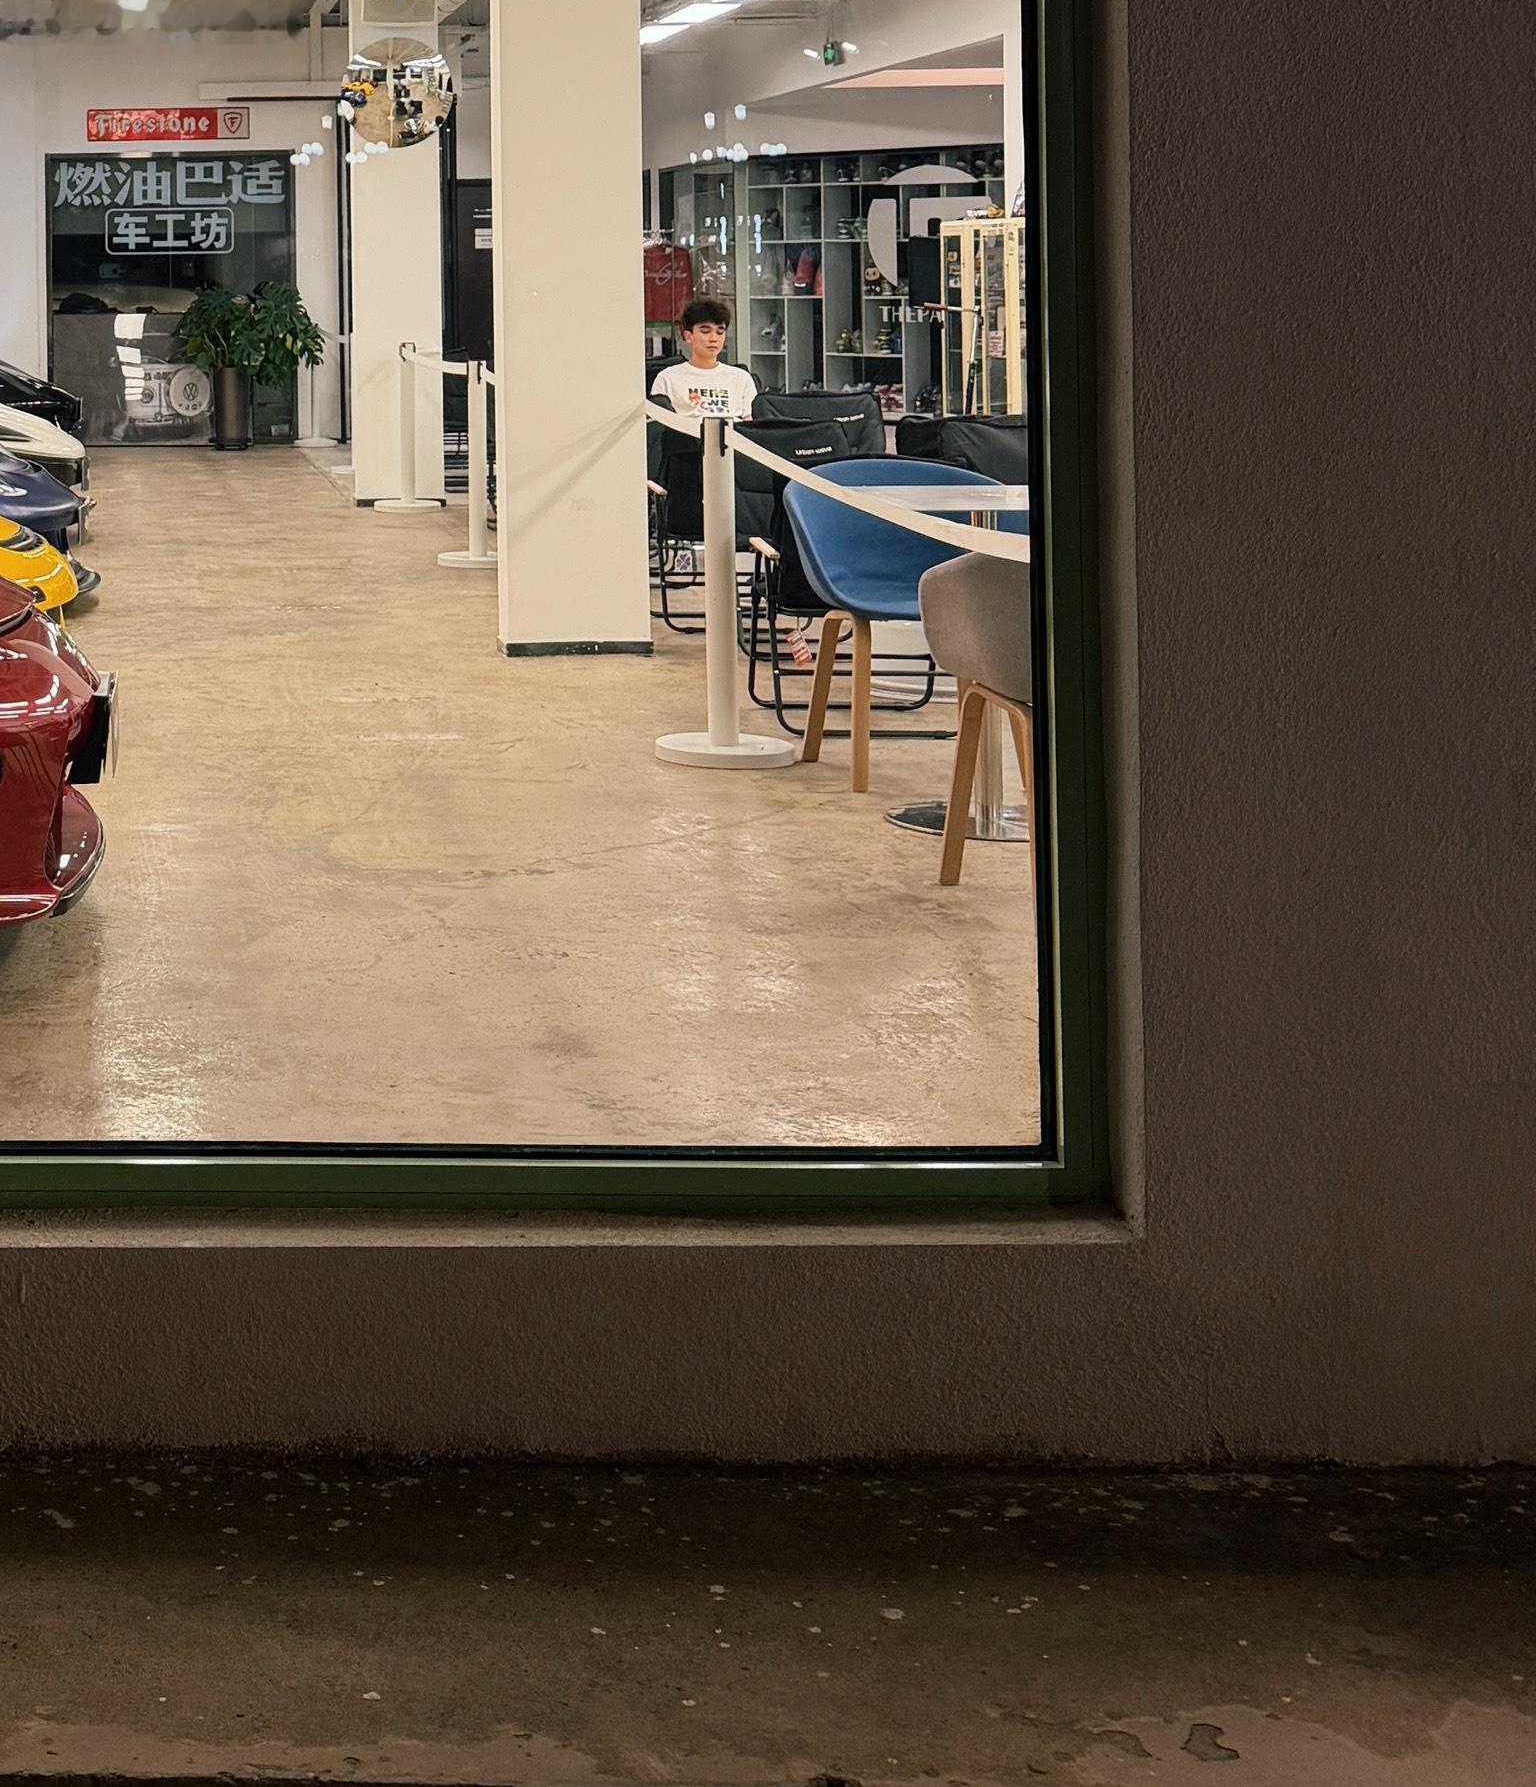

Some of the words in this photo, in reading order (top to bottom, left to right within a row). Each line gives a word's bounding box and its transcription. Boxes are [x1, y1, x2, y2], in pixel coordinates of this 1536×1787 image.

[94, 114, 210, 138] Firestone
[54, 159, 285, 207] 燃油巴适
[112, 212, 228, 250] 车工坊
